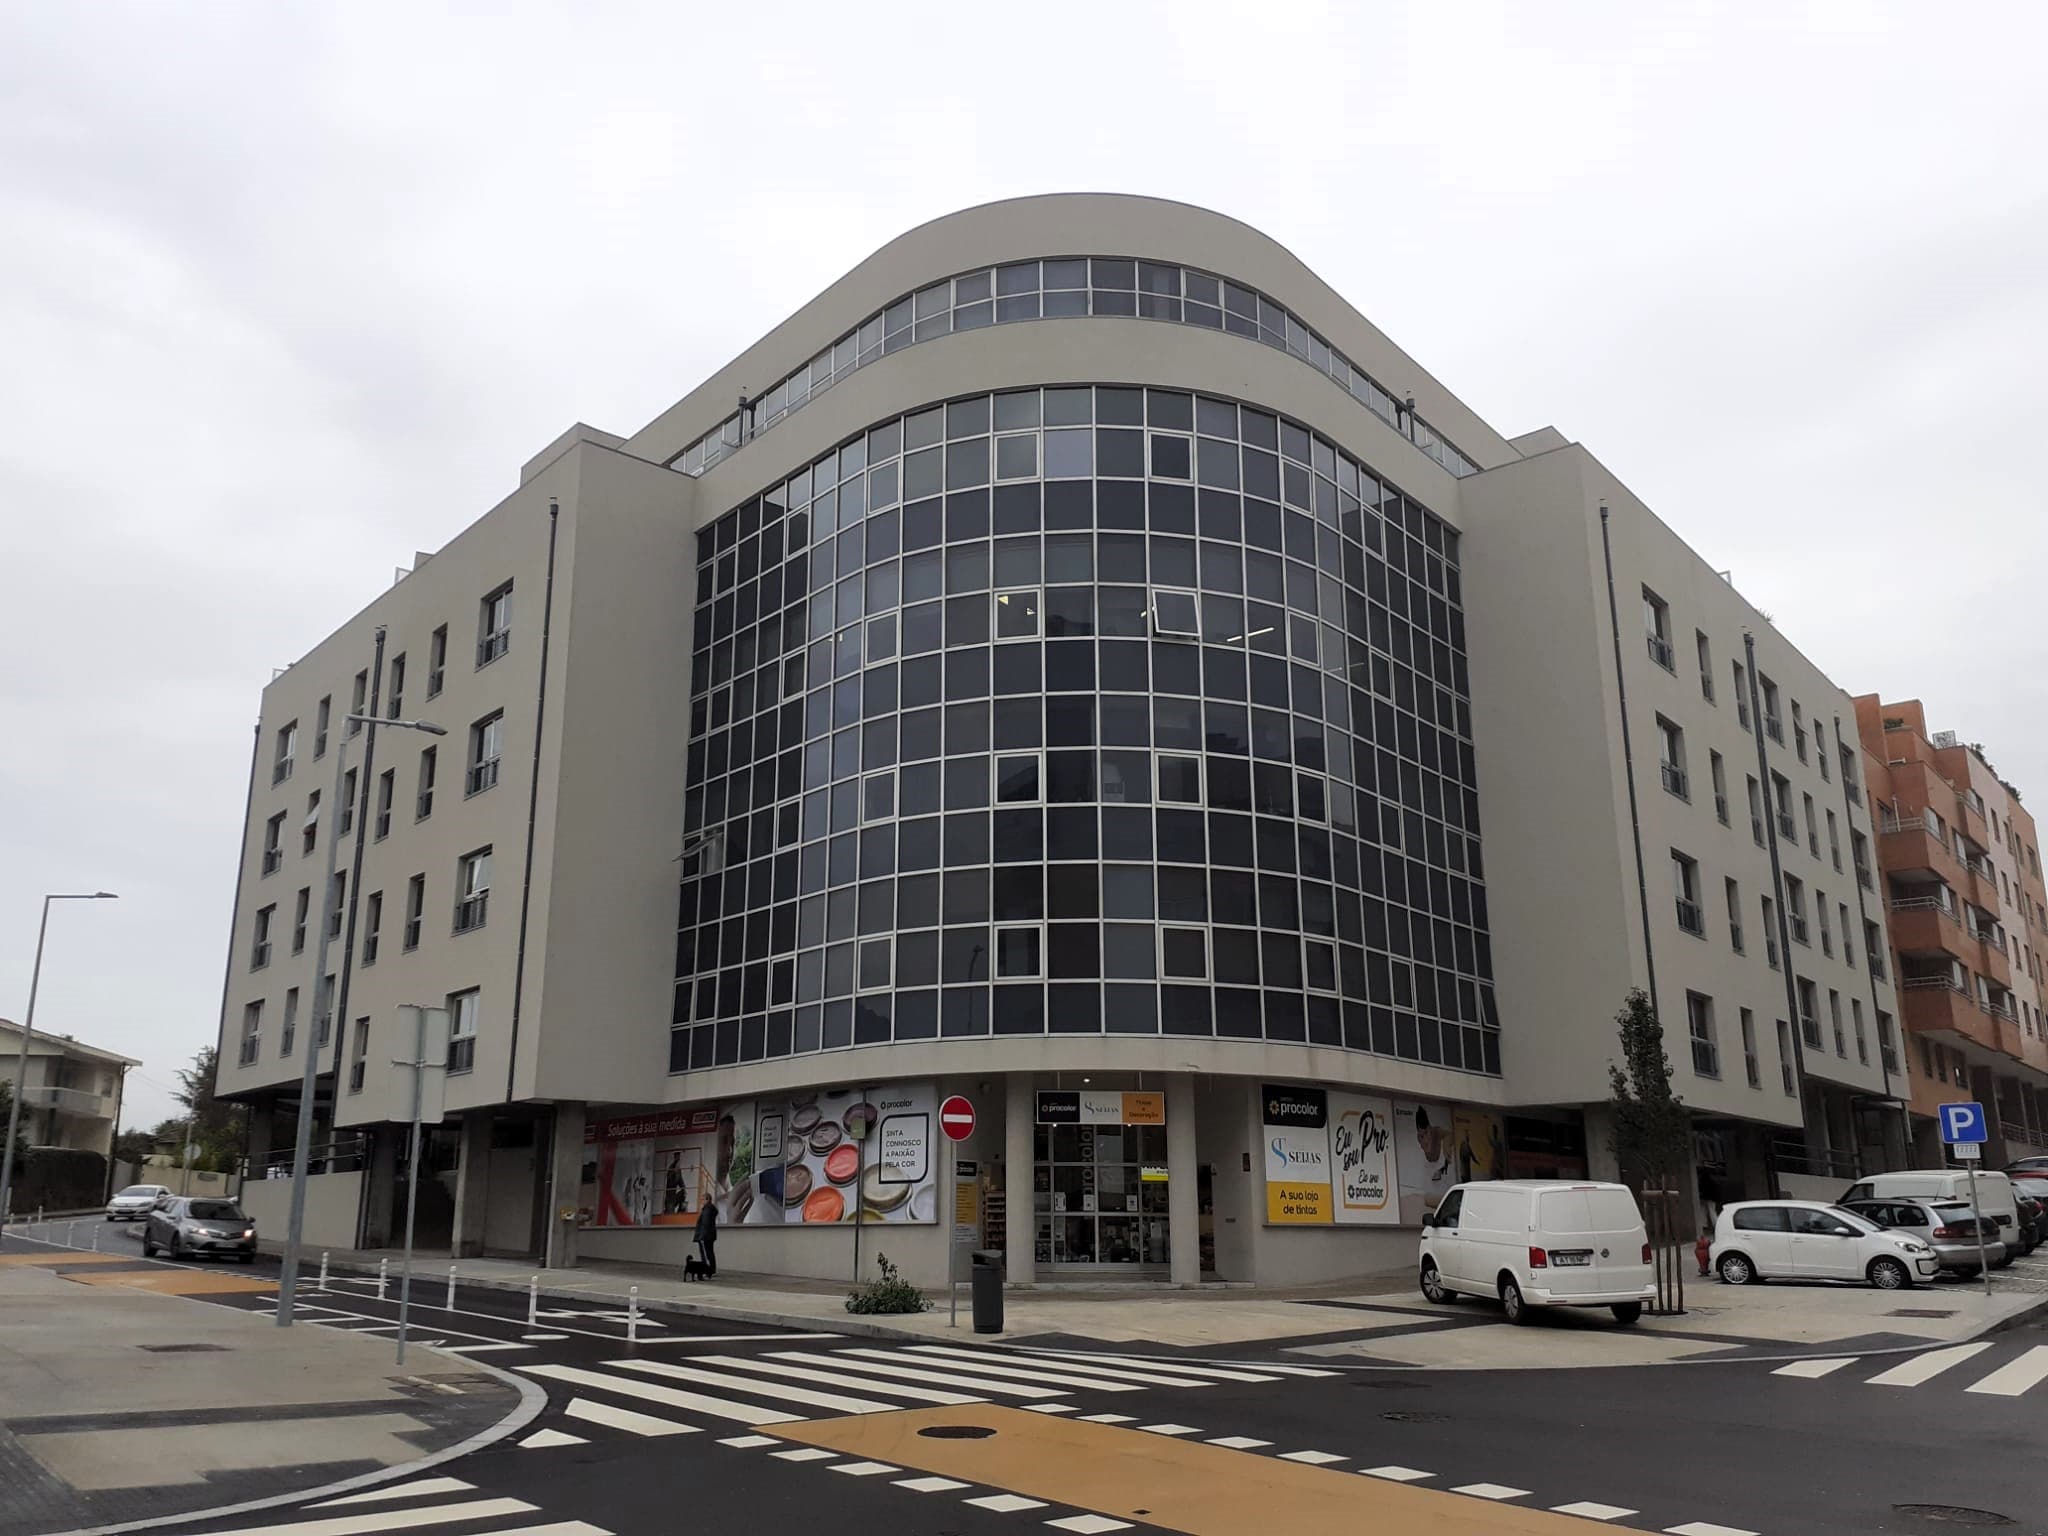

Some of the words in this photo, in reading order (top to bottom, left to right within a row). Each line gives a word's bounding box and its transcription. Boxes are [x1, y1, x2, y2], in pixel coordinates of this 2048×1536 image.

[887, 1100, 912, 1110] procolor
[1281, 1102, 1318, 1116] procolor
[608, 1121, 637, 1137] Soluções
[1948, 1107, 1974, 1139] P
[1336, 1126, 1353, 1155] Eu
[1289, 1152, 1321, 1164] SEIJAS
[1343, 1148, 1359, 1171] sou
[1280, 1190, 1287, 1199] A
[1288, 1192, 1304, 1201] sua
[1305, 1190, 1319, 1203] loja
[1355, 1186, 1384, 1200] procolor
[1283, 1204, 1295, 1215] de
[1296, 1204, 1317, 1215] tintas
